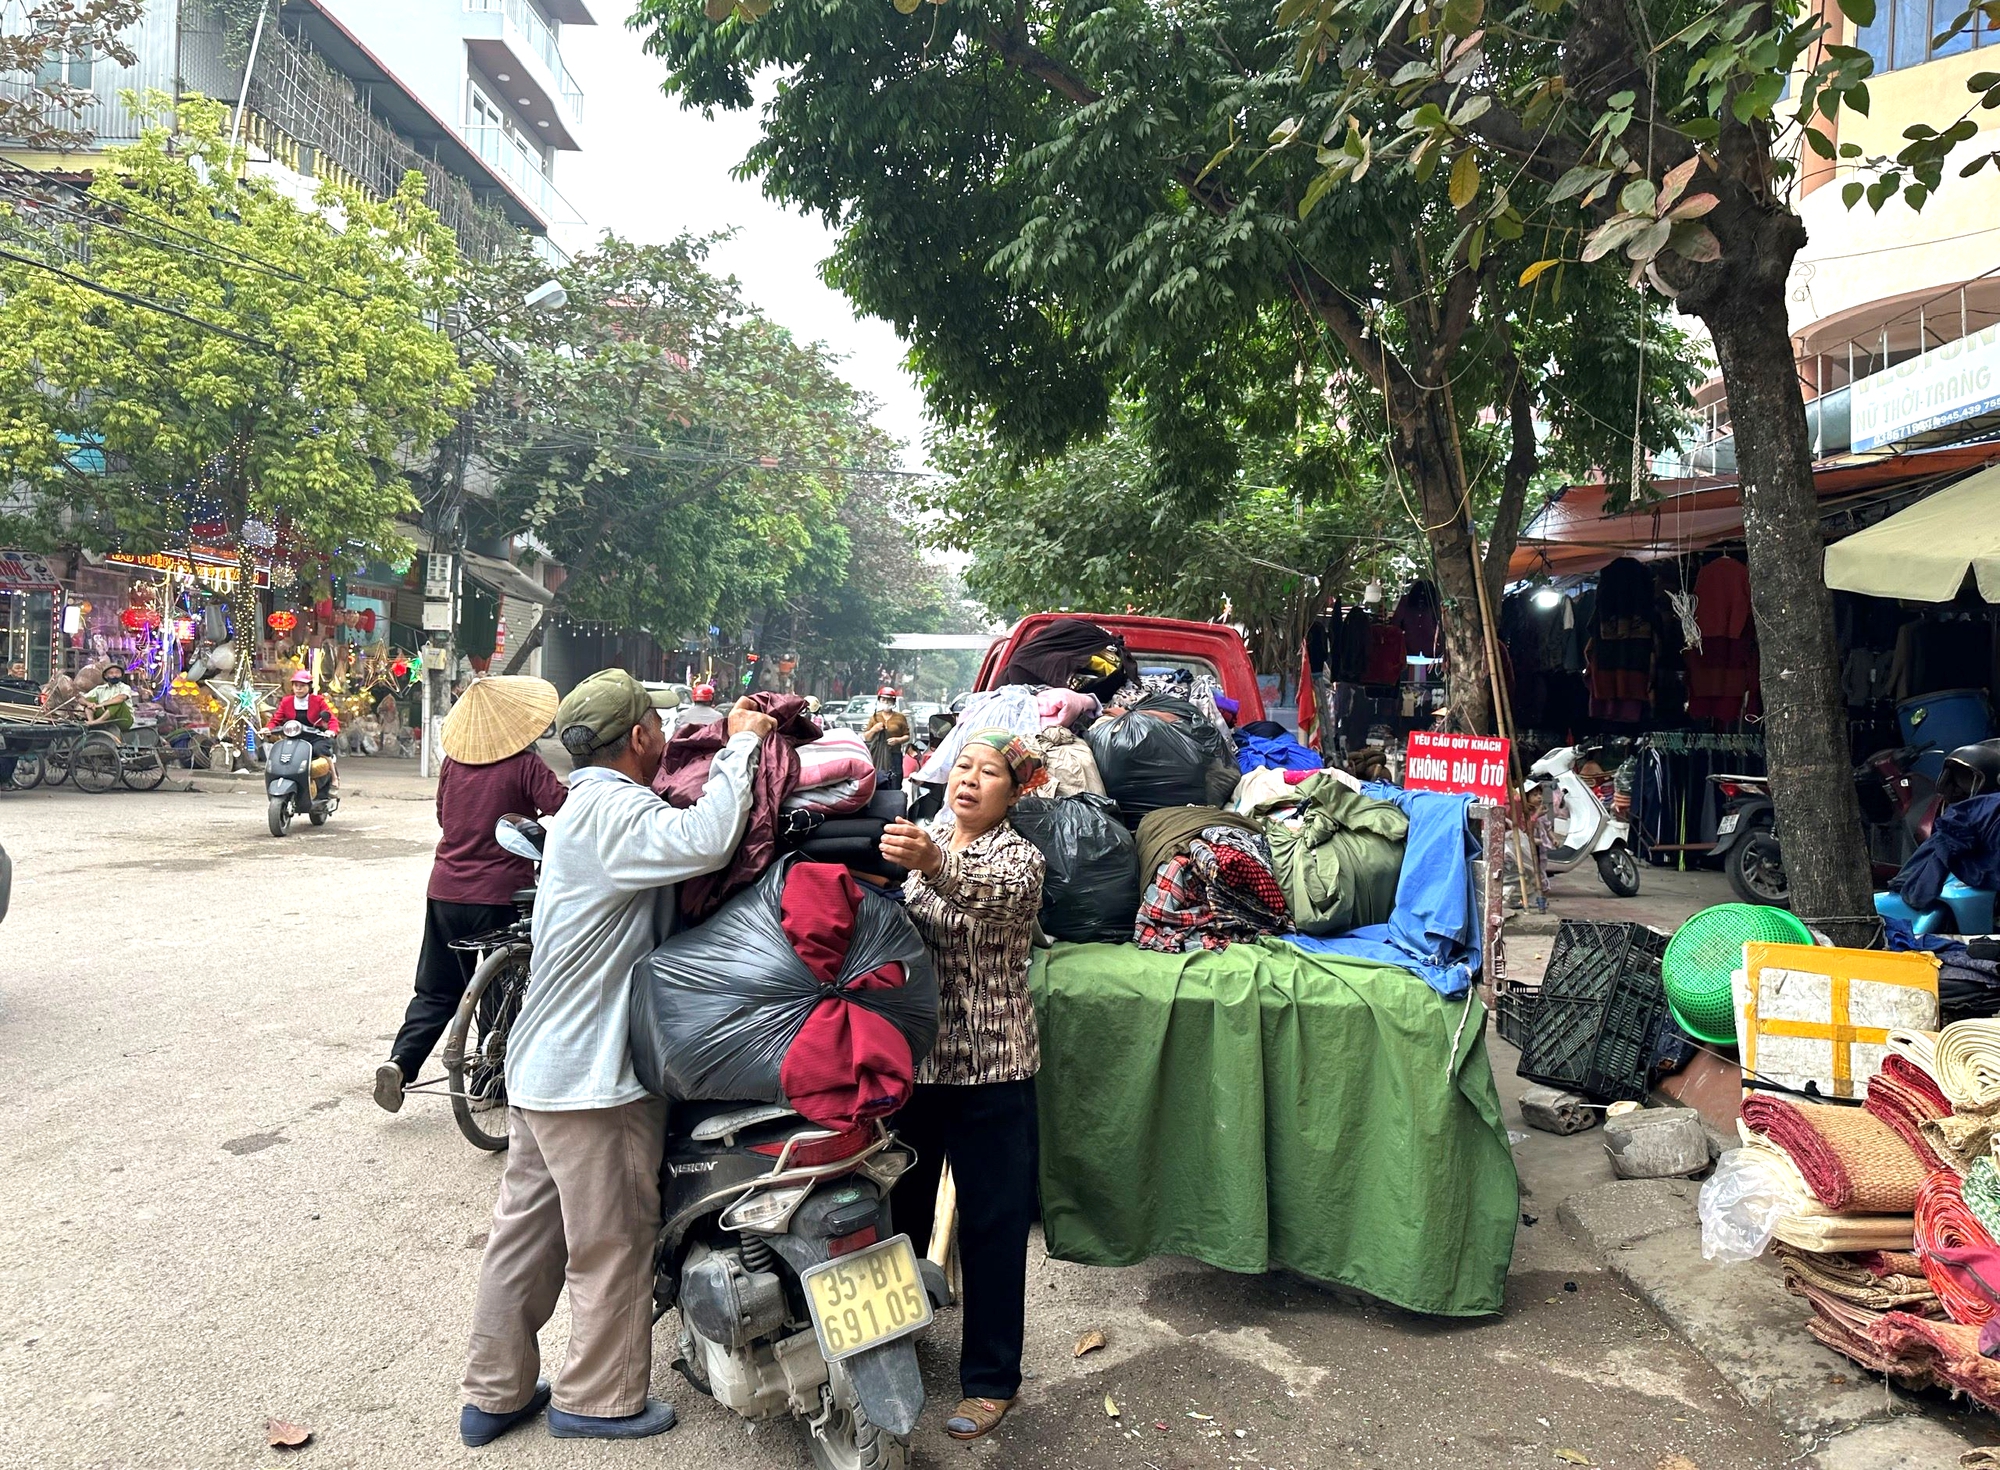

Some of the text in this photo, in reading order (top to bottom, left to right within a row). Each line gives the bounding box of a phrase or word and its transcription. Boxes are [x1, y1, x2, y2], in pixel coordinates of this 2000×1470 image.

[1415, 733, 1430, 746] YÊU
[1471, 738, 1502, 752] KHÁCH
[1408, 754, 1505, 788] KHÔNG ĐẬU ÔTÔ
[667, 1160, 719, 1178] VISION
[824, 1283, 923, 1351] 691.05
